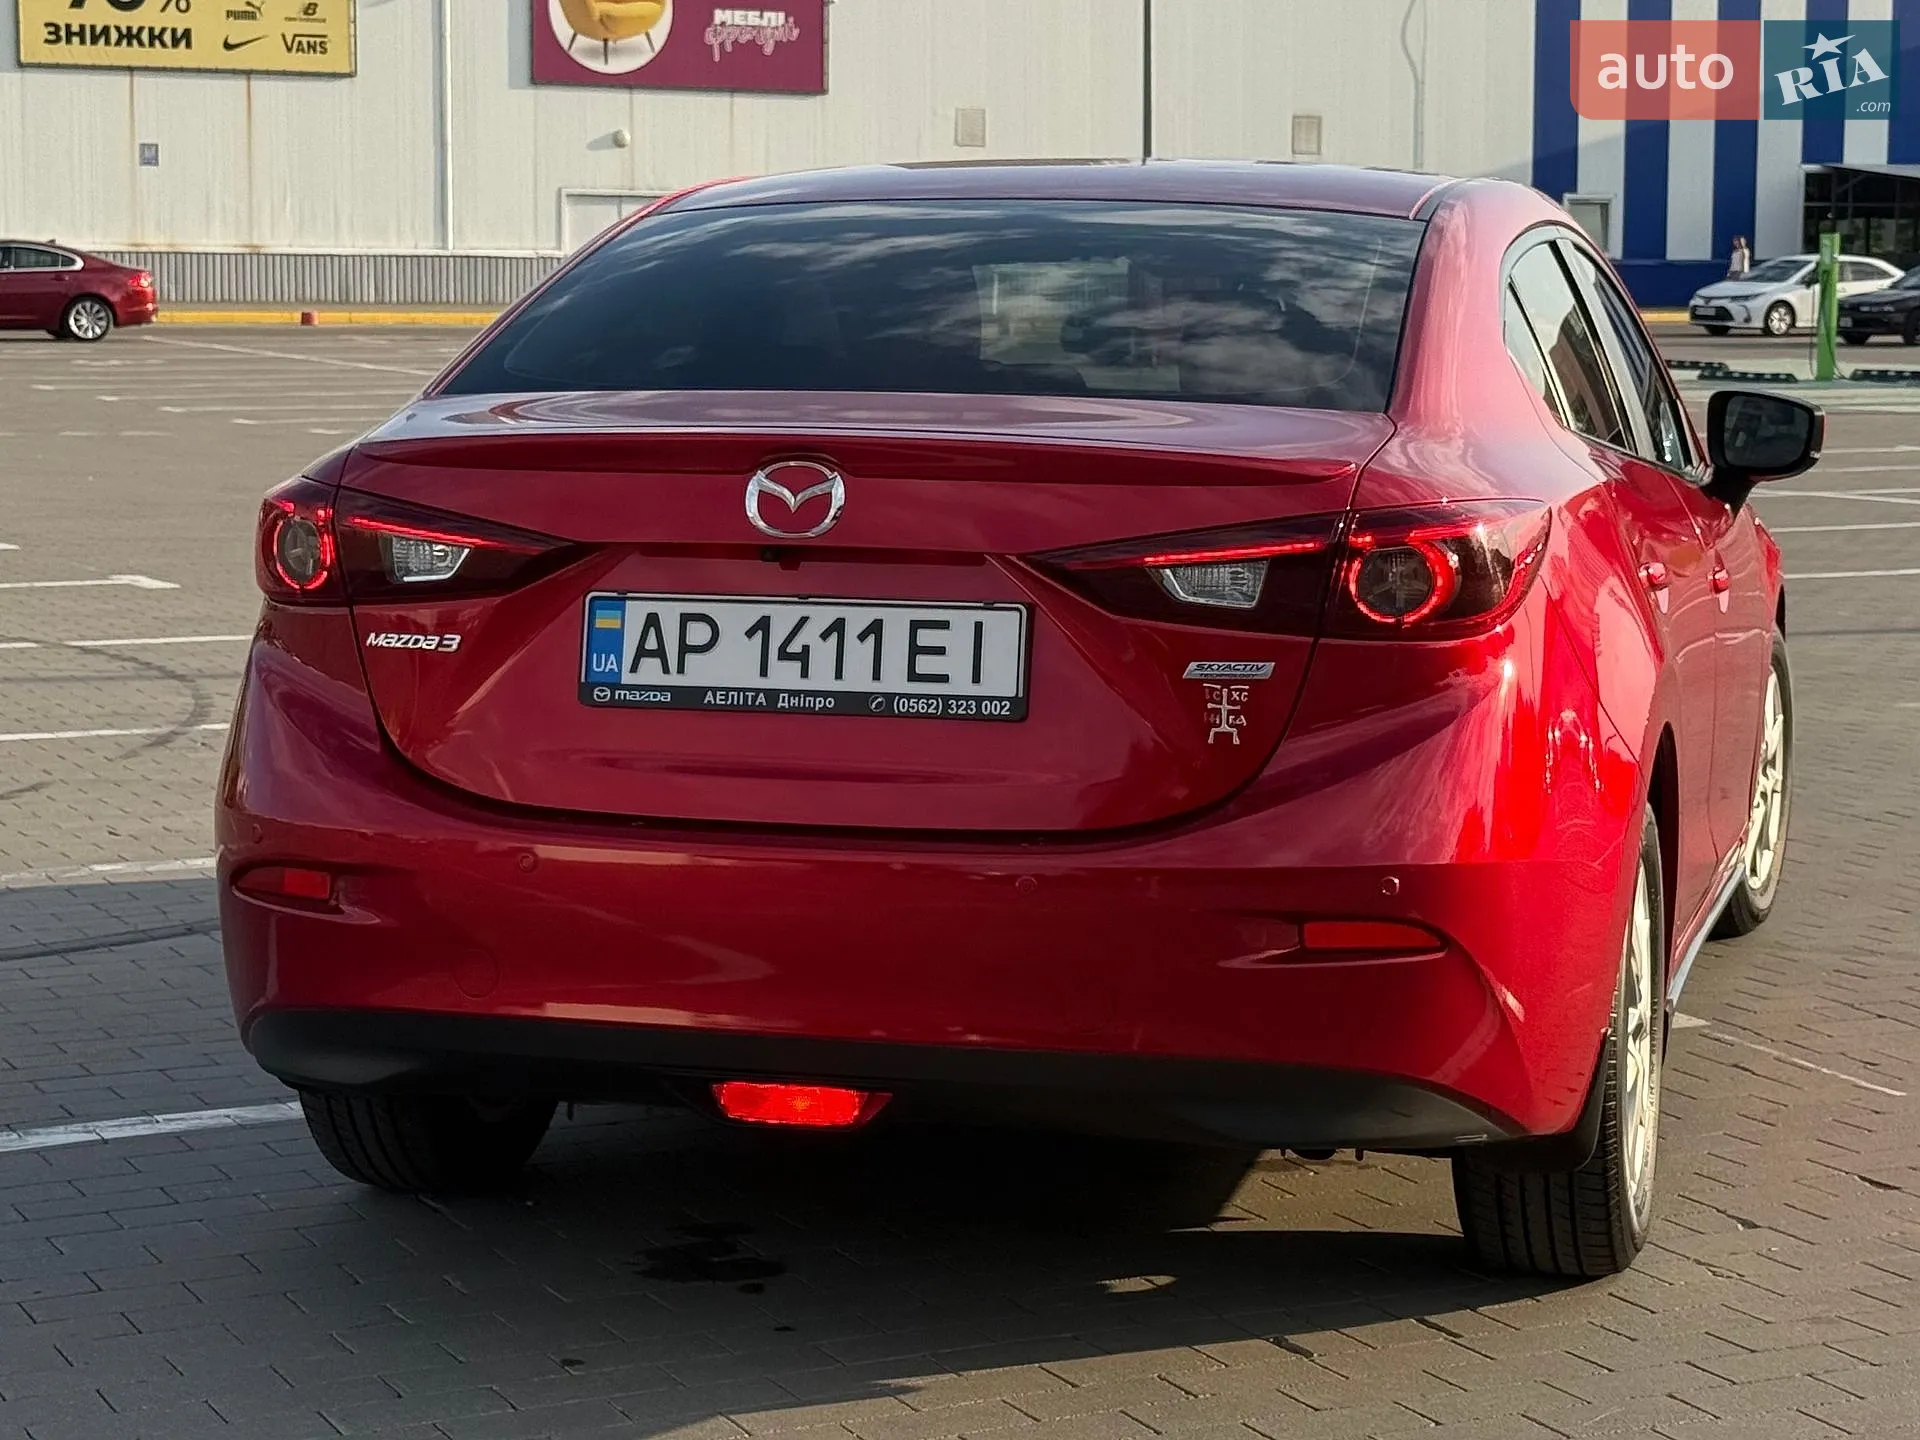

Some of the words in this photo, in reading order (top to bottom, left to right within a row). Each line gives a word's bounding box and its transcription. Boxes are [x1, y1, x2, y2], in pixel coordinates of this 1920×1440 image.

[713, 8, 786, 27] МЕБЛІ
[43, 22, 193, 50] ЗНИЖКИ
[281, 33, 328, 55] VANS
[629, 612, 721, 675] AP
[744, 615, 884, 682] 1411
[907, 620, 984, 684] EI
[592, 653, 619, 673] UA
[1194, 663, 1267, 672] SKYACTIV
[704, 690, 767, 706] АЕЛІТА
[777, 693, 835, 711] Дніпро
[893, 695, 943, 716] (0562)
[948, 701, 977, 714] 323
[981, 701, 1011, 716] 002
